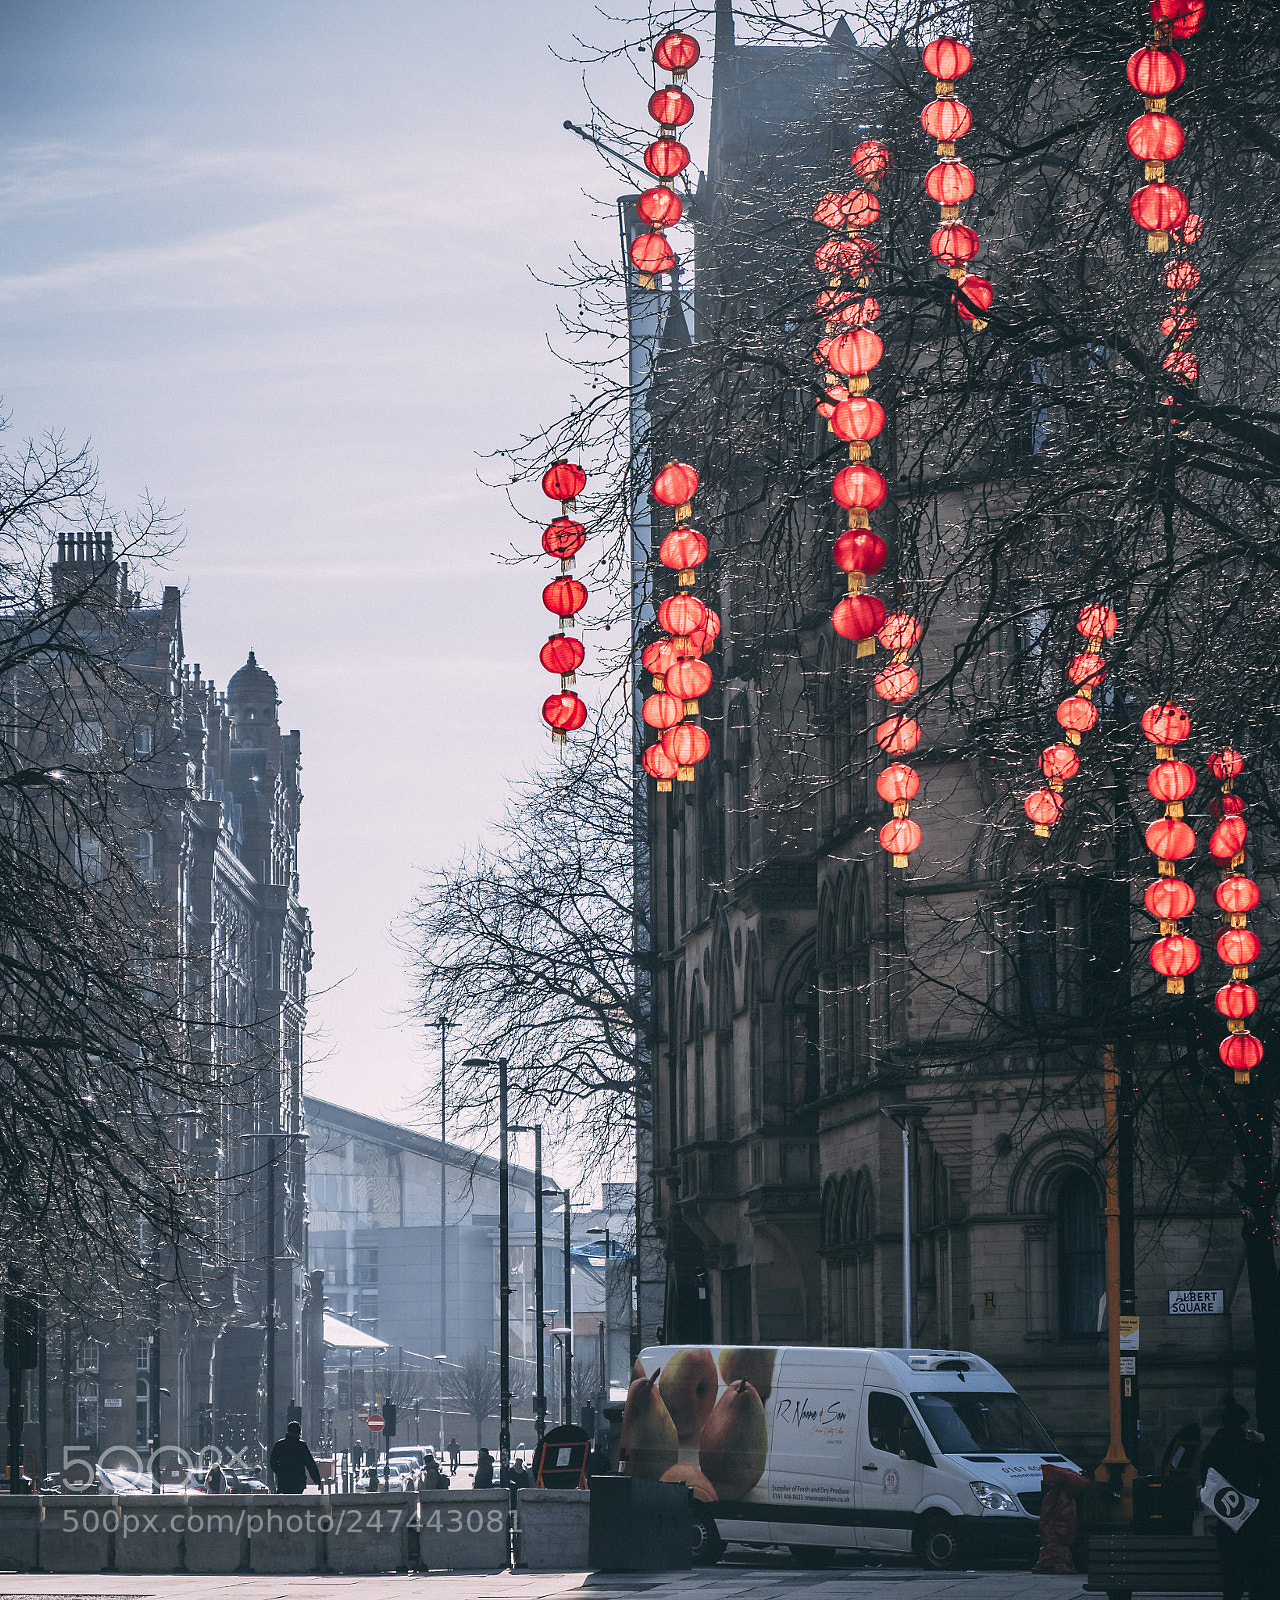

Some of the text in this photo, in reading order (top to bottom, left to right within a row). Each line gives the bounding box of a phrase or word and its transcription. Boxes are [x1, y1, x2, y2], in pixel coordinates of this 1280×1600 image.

[1175, 1292, 1217, 1302] ALBERT
[1172, 1302, 1214, 1313] SQUARE
[776, 1399, 792, 1424] R
[772, 1484, 791, 1492] Supplier
[797, 1485, 810, 1493] Fresh
[820, 1486, 829, 1494] Dry
[830, 1487, 850, 1495] Produce
[1220, 1490, 1240, 1516] JD
